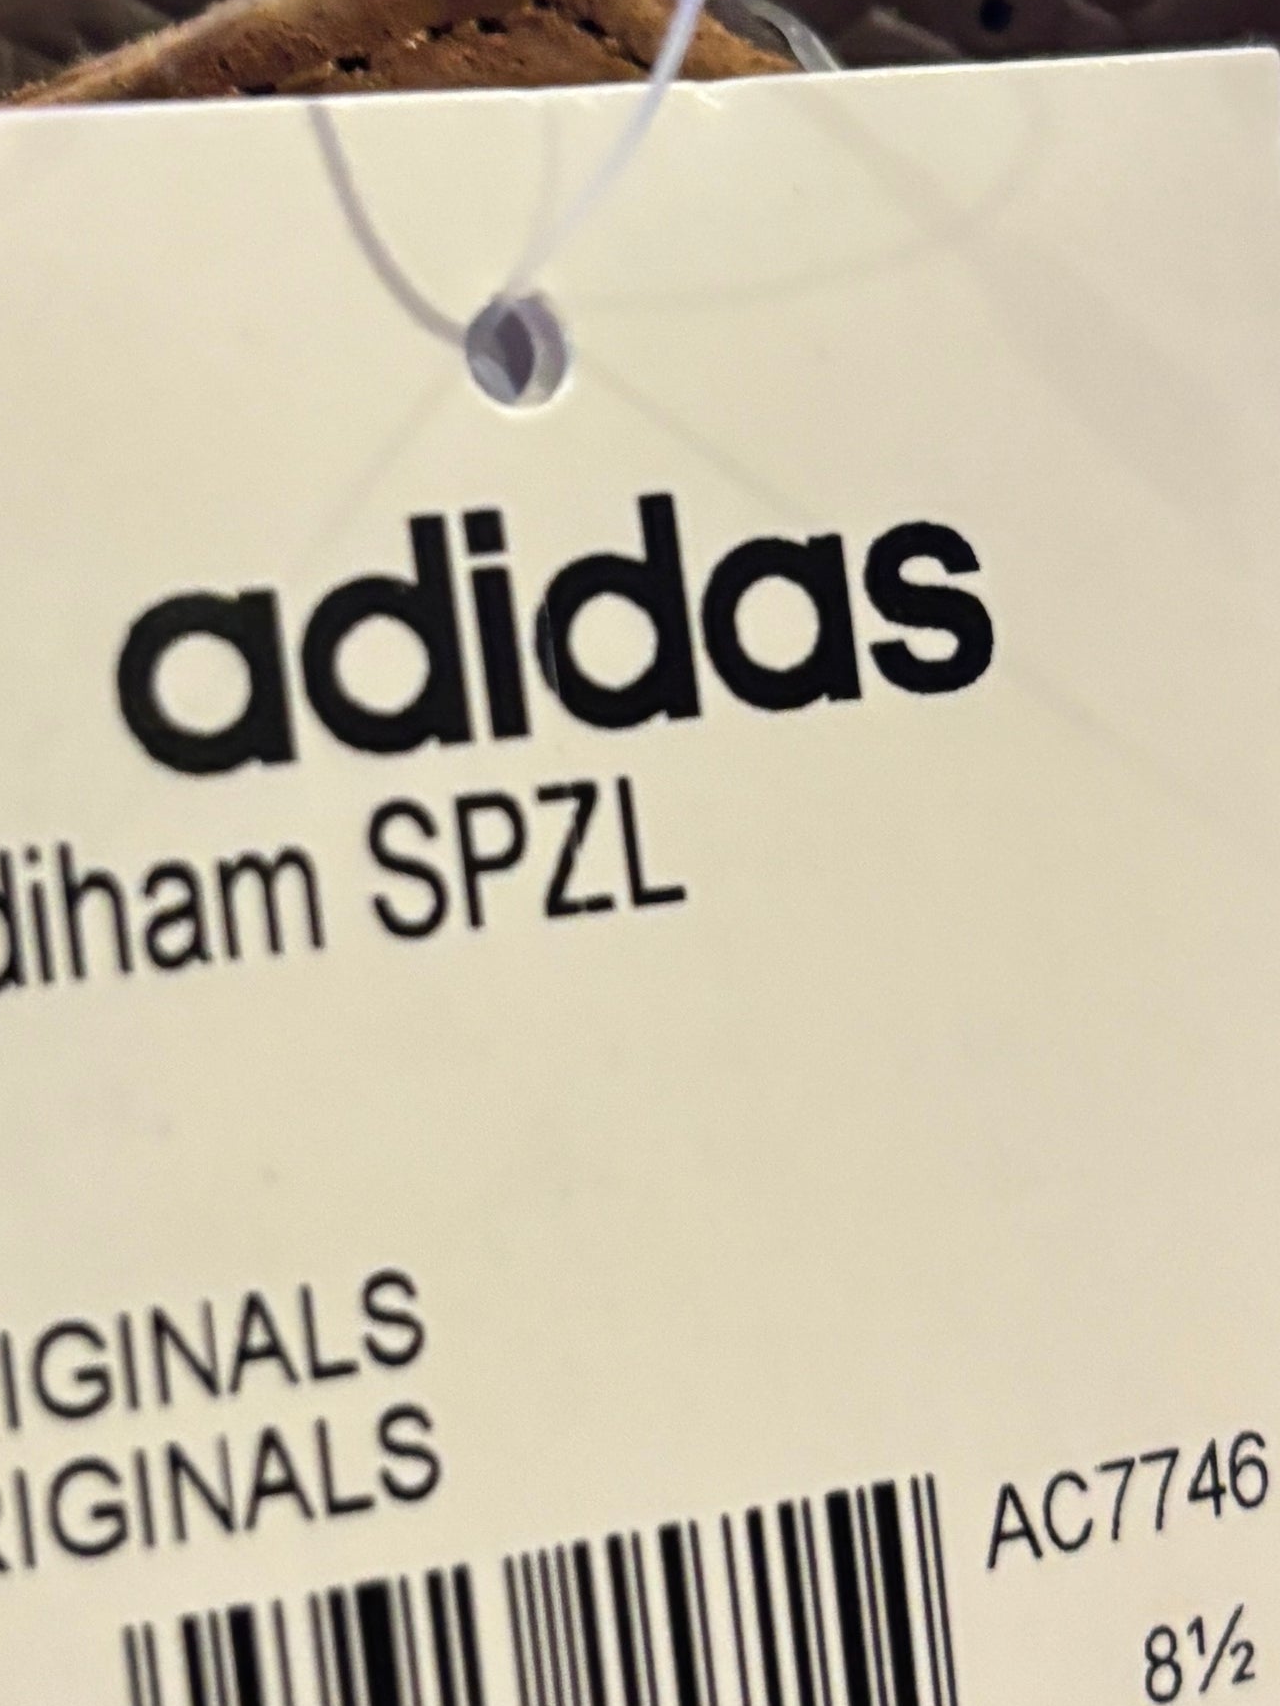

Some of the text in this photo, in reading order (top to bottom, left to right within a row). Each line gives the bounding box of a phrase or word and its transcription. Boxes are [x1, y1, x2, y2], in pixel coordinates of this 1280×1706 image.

[115, 492, 995, 777] adidas
[366, 775, 687, 941] SPZL
[986, 1430, 1270, 1571] AC7746
